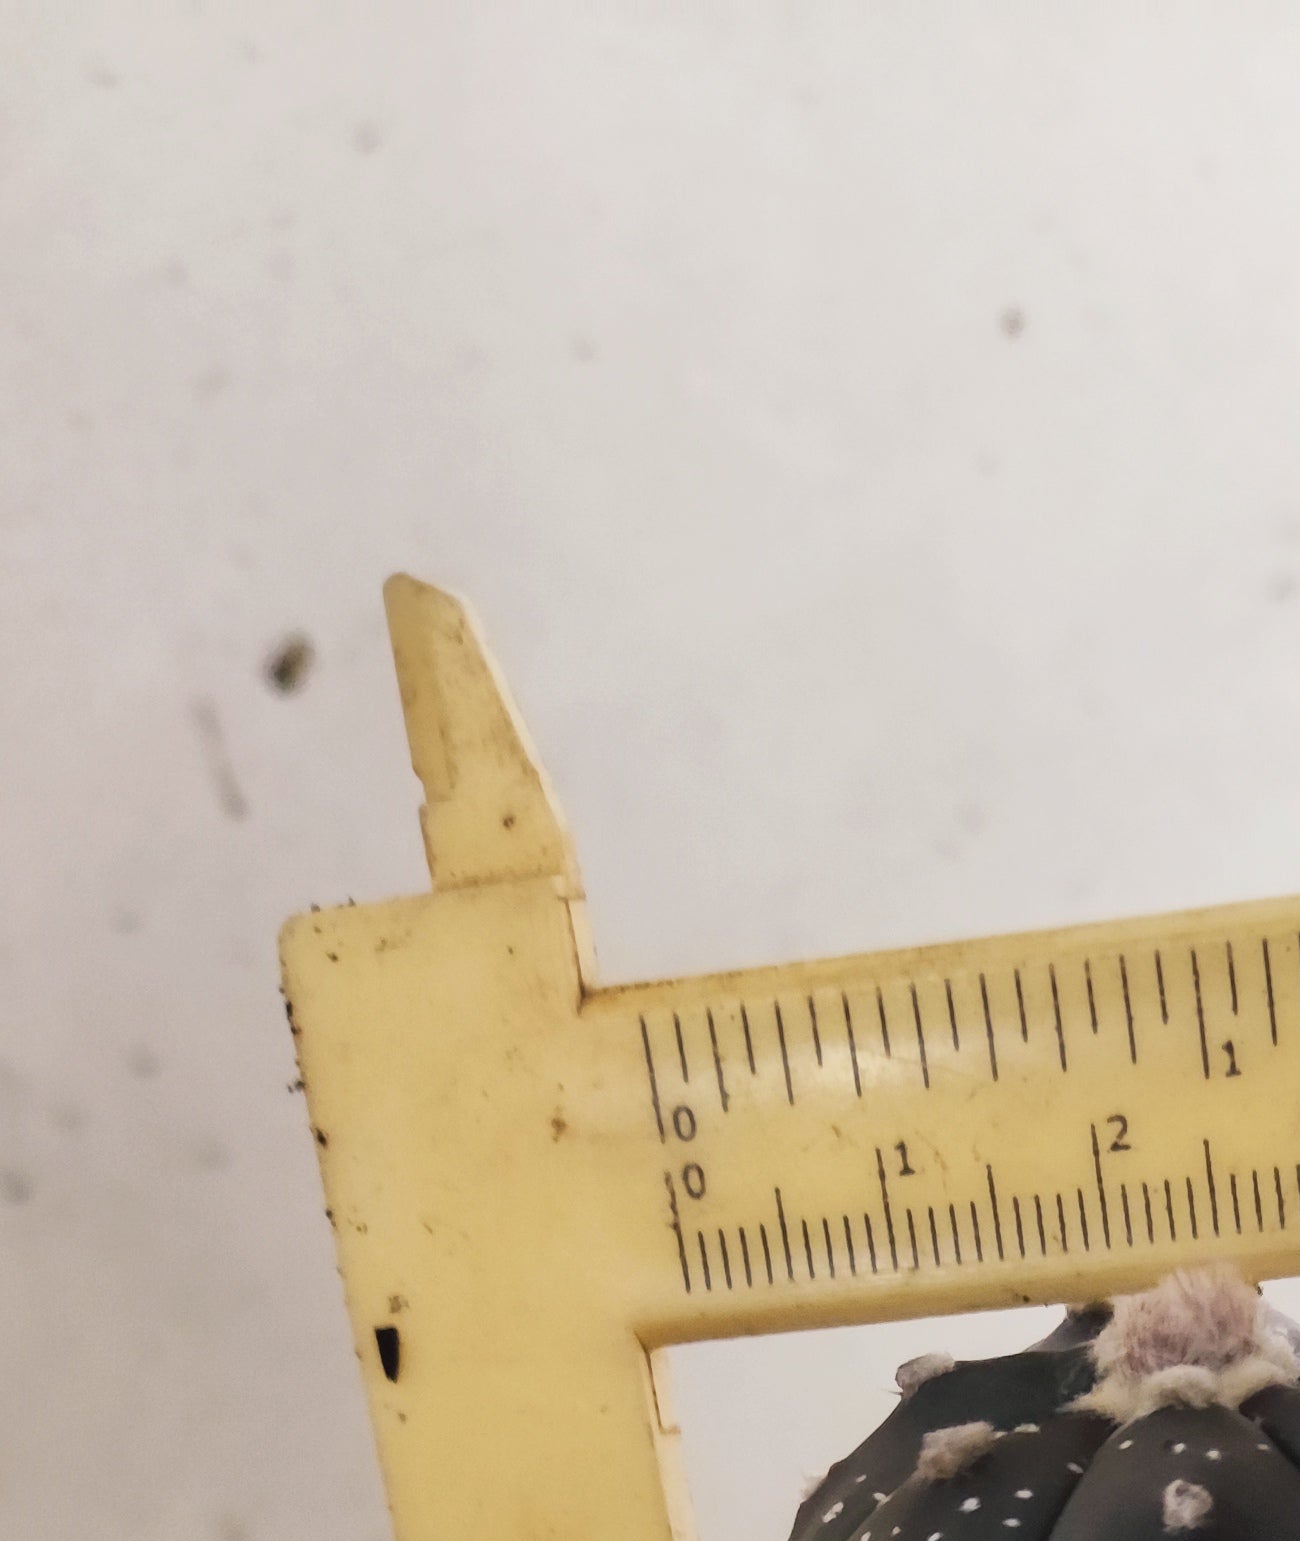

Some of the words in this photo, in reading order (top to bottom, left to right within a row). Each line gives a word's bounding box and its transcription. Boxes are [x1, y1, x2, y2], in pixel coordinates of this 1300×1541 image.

[672, 1106, 697, 1142] 0
[1222, 1040, 1241, 1077] 1
[681, 1163, 706, 1200] 0
[895, 1141, 915, 1176] 1
[1107, 1114, 1131, 1152] 2
